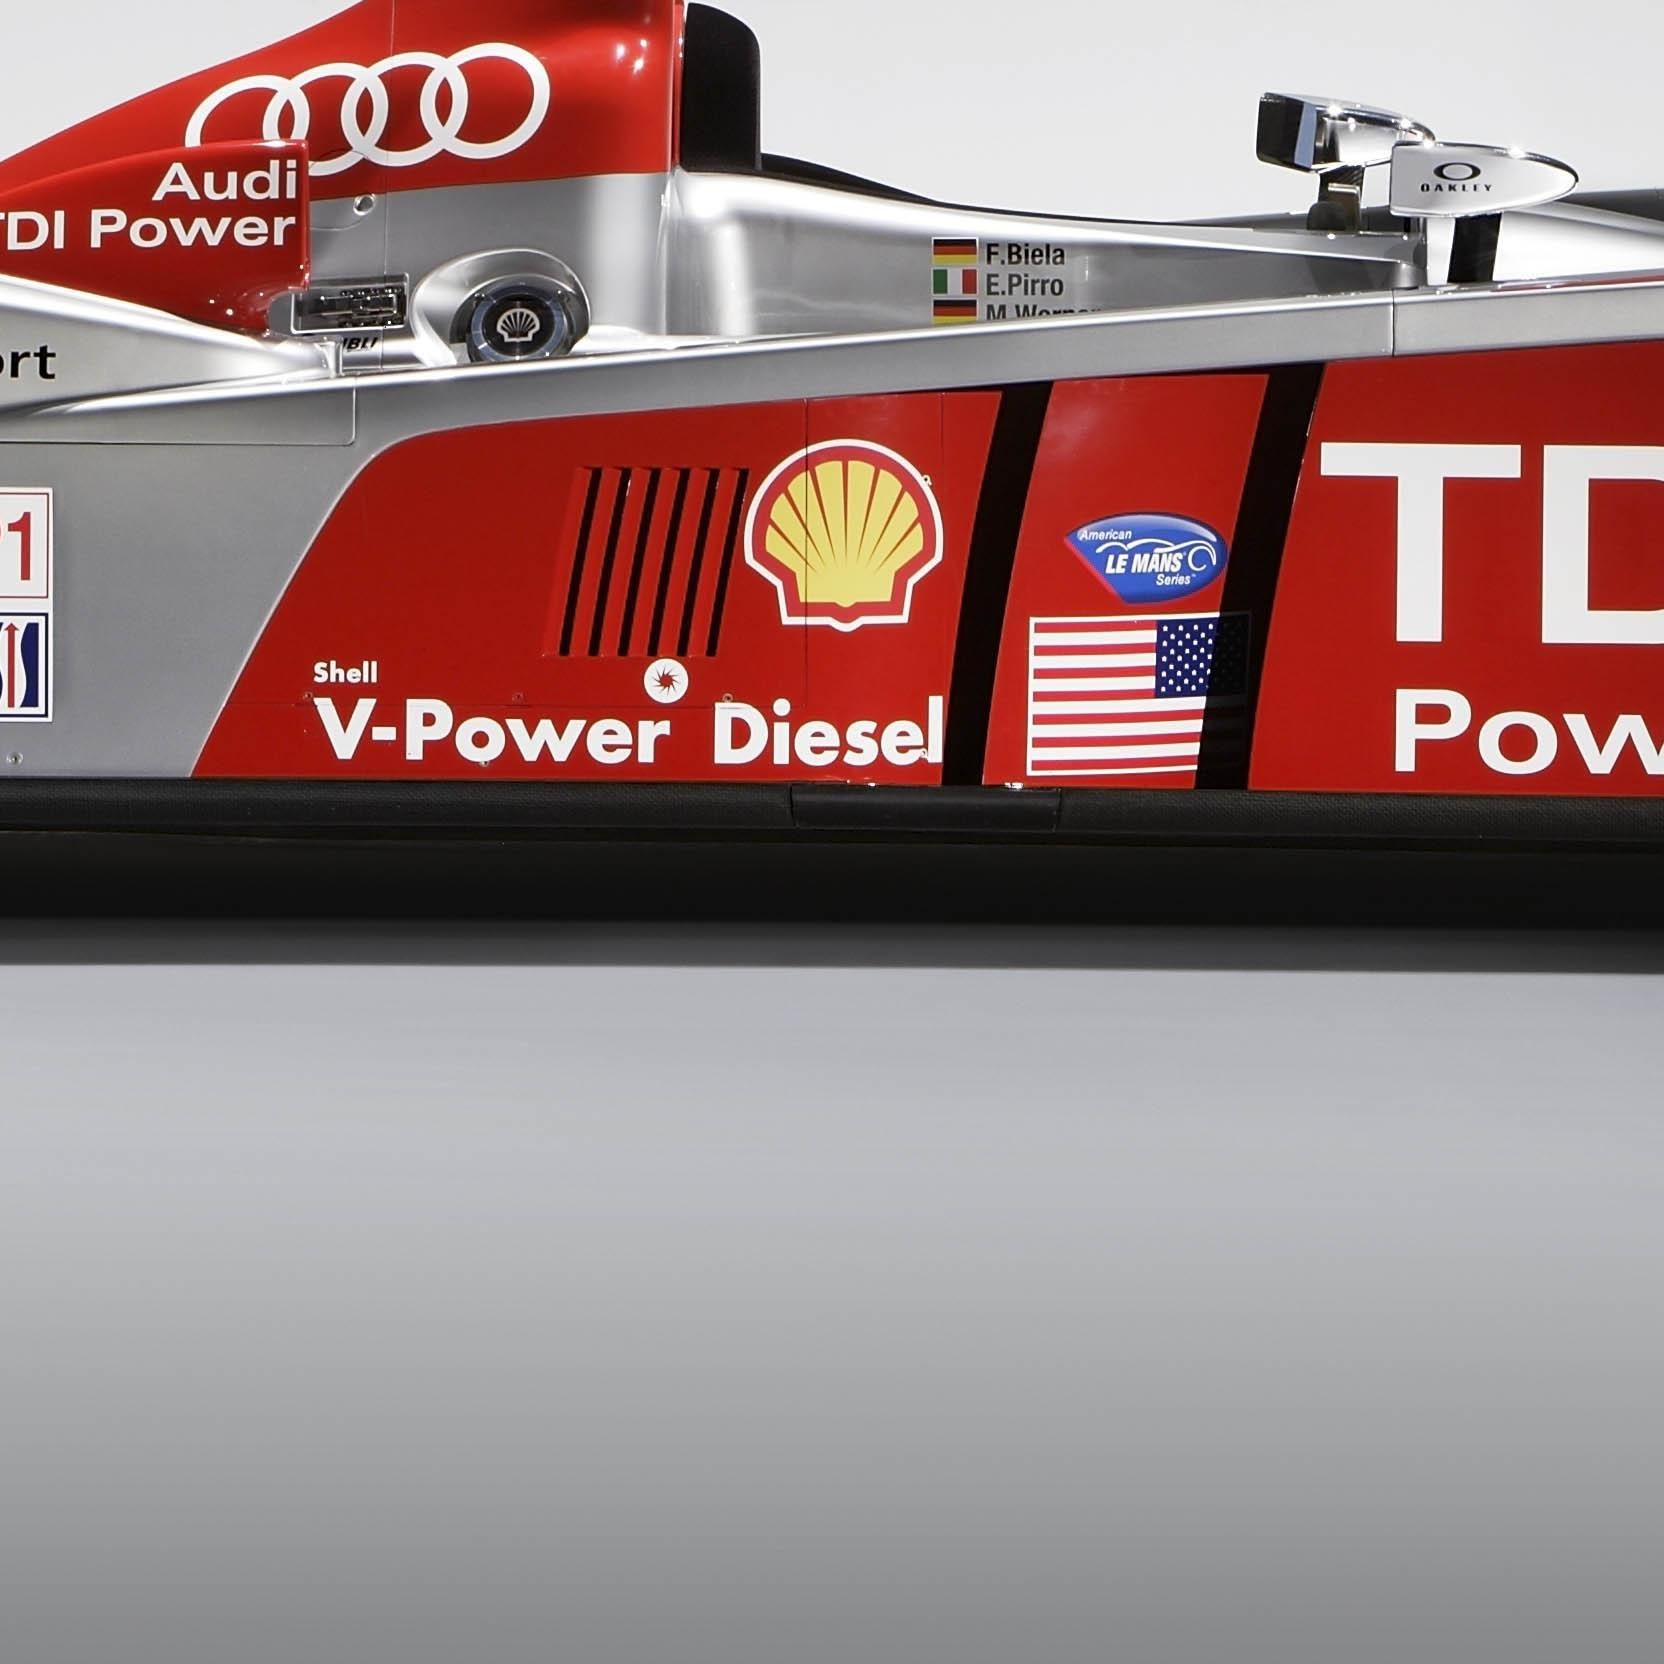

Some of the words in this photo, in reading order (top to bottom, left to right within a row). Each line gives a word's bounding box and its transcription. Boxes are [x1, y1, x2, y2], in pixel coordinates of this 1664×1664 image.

[151, 159, 297, 202] Audi
[1420, 183, 1493, 193] OAKLEY
[90, 208, 297, 249] Power
[986, 243, 1065, 266] F.Biela
[986, 273, 1064, 296] E.Pirro
[1078, 529, 1133, 541] American
[1105, 553, 1129, 574] LE
[313, 660, 378, 684] Shell
[313, 697, 671, 766] V-Power
[713, 695, 944, 767] Diesel
